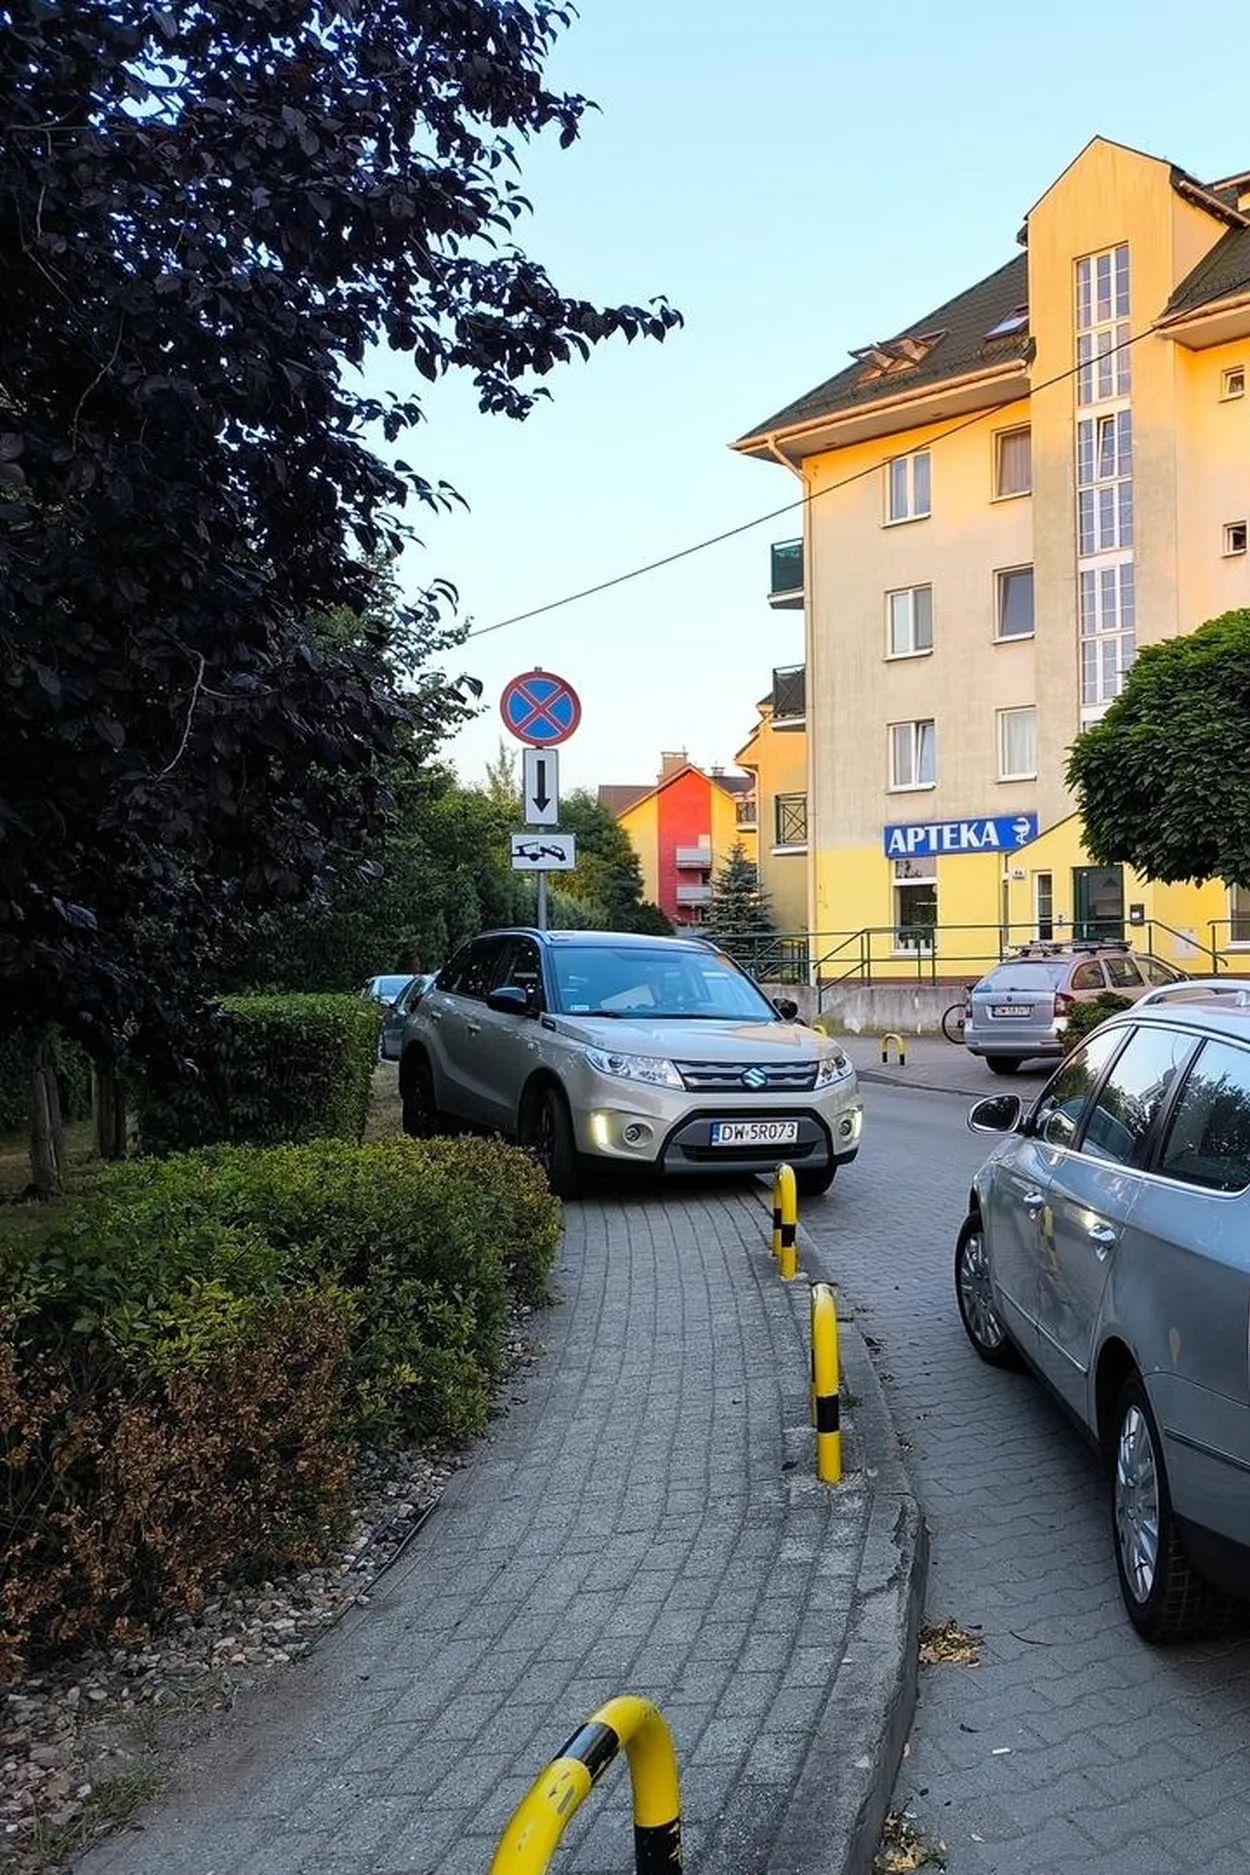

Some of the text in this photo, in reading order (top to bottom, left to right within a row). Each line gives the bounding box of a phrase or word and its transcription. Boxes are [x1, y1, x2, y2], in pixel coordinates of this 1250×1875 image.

[888, 820, 1000, 854] APTEKA
[722, 1125, 746, 1141] DW
[750, 1123, 796, 1139] 5R073
